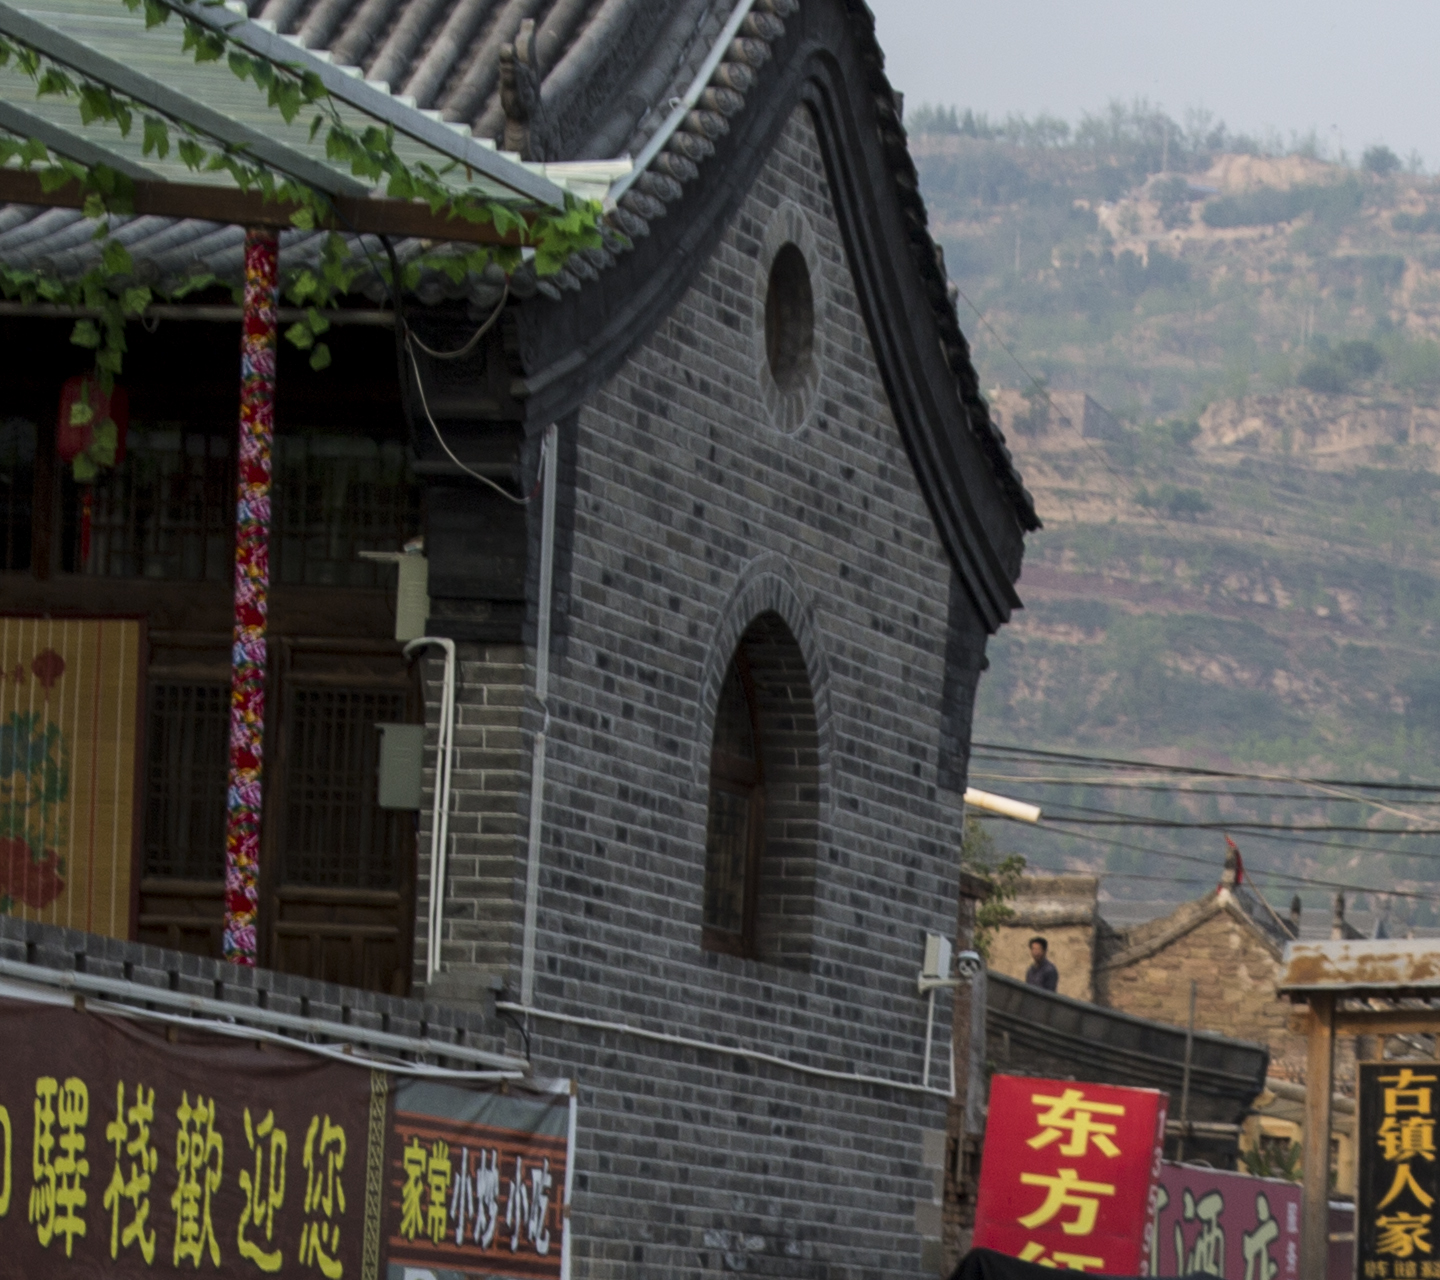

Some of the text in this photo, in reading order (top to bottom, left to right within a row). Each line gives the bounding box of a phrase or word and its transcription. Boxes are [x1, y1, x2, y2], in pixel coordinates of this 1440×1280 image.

[399, 1136, 552, 1255] 家常小炒 小吃
[1375, 1068, 1438, 1258] 古镇人家
